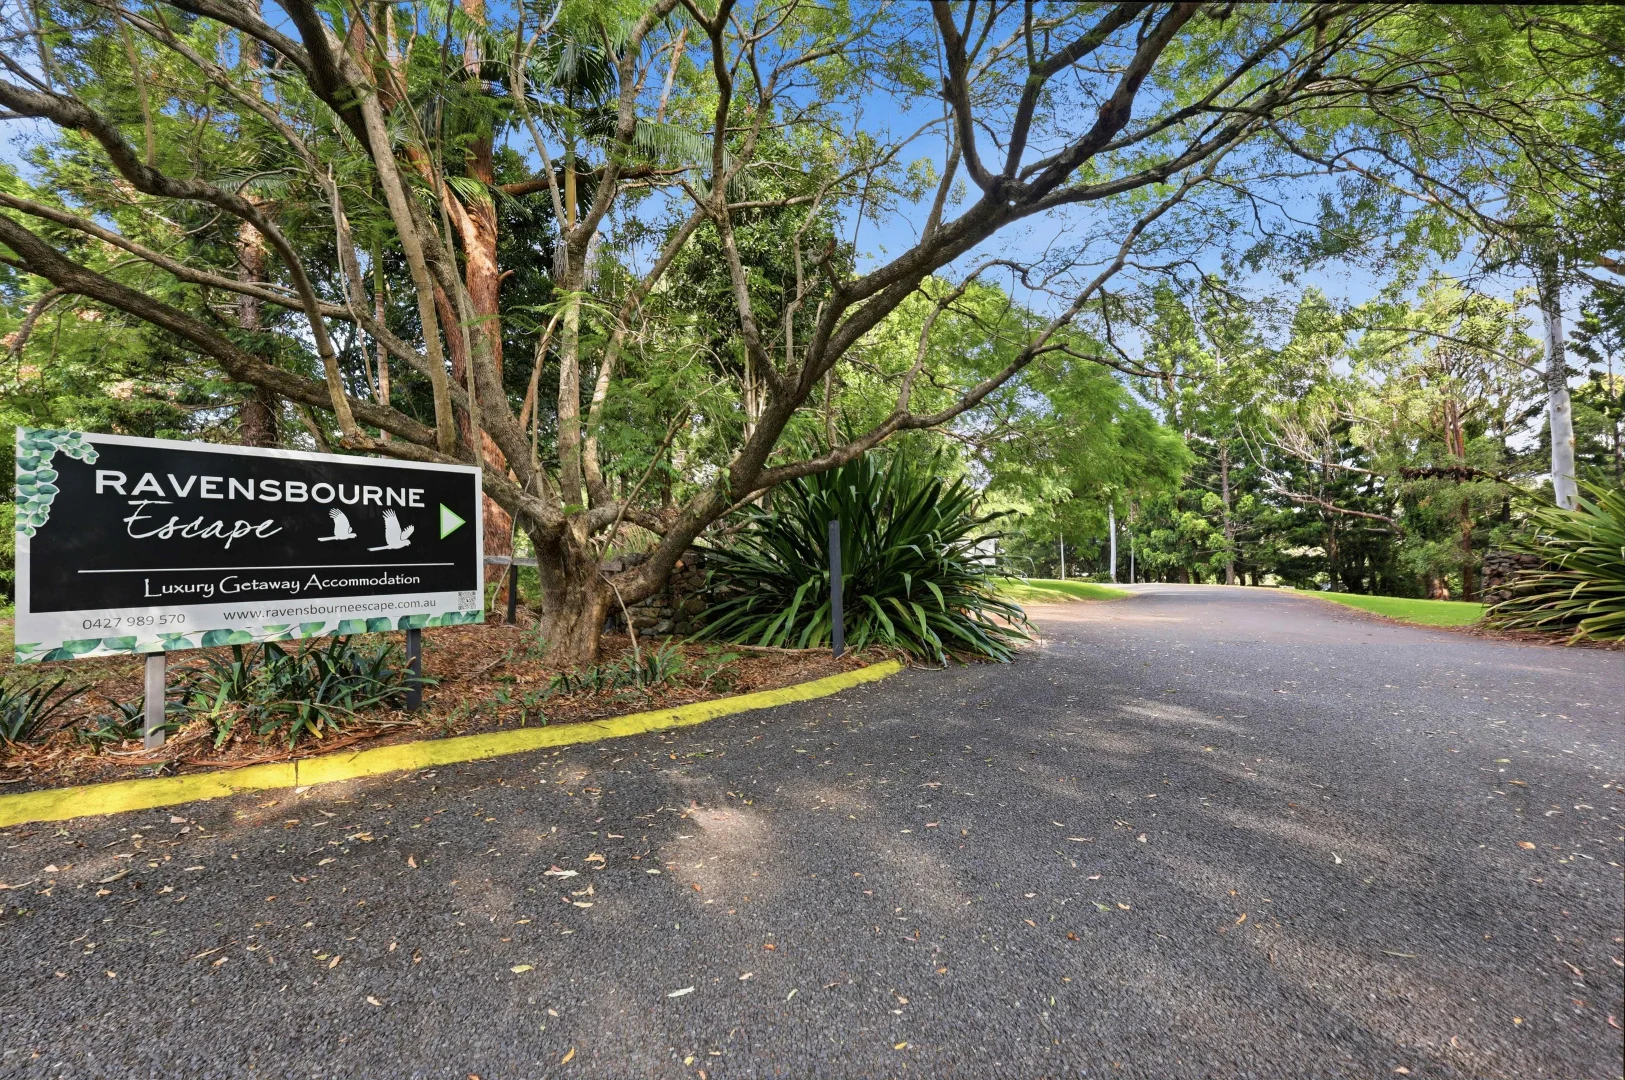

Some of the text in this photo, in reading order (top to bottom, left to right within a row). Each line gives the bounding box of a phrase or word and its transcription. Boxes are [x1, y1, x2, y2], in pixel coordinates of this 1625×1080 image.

[95, 469, 425, 508] RAVENSBOURNE
[123, 499, 282, 549] Escape
[144, 572, 420, 598] Luxury Getaway Accommodation
[82, 613, 186, 630] 0427 989 570
[223, 598, 436, 621] www.ravensbourneescape.com.au
